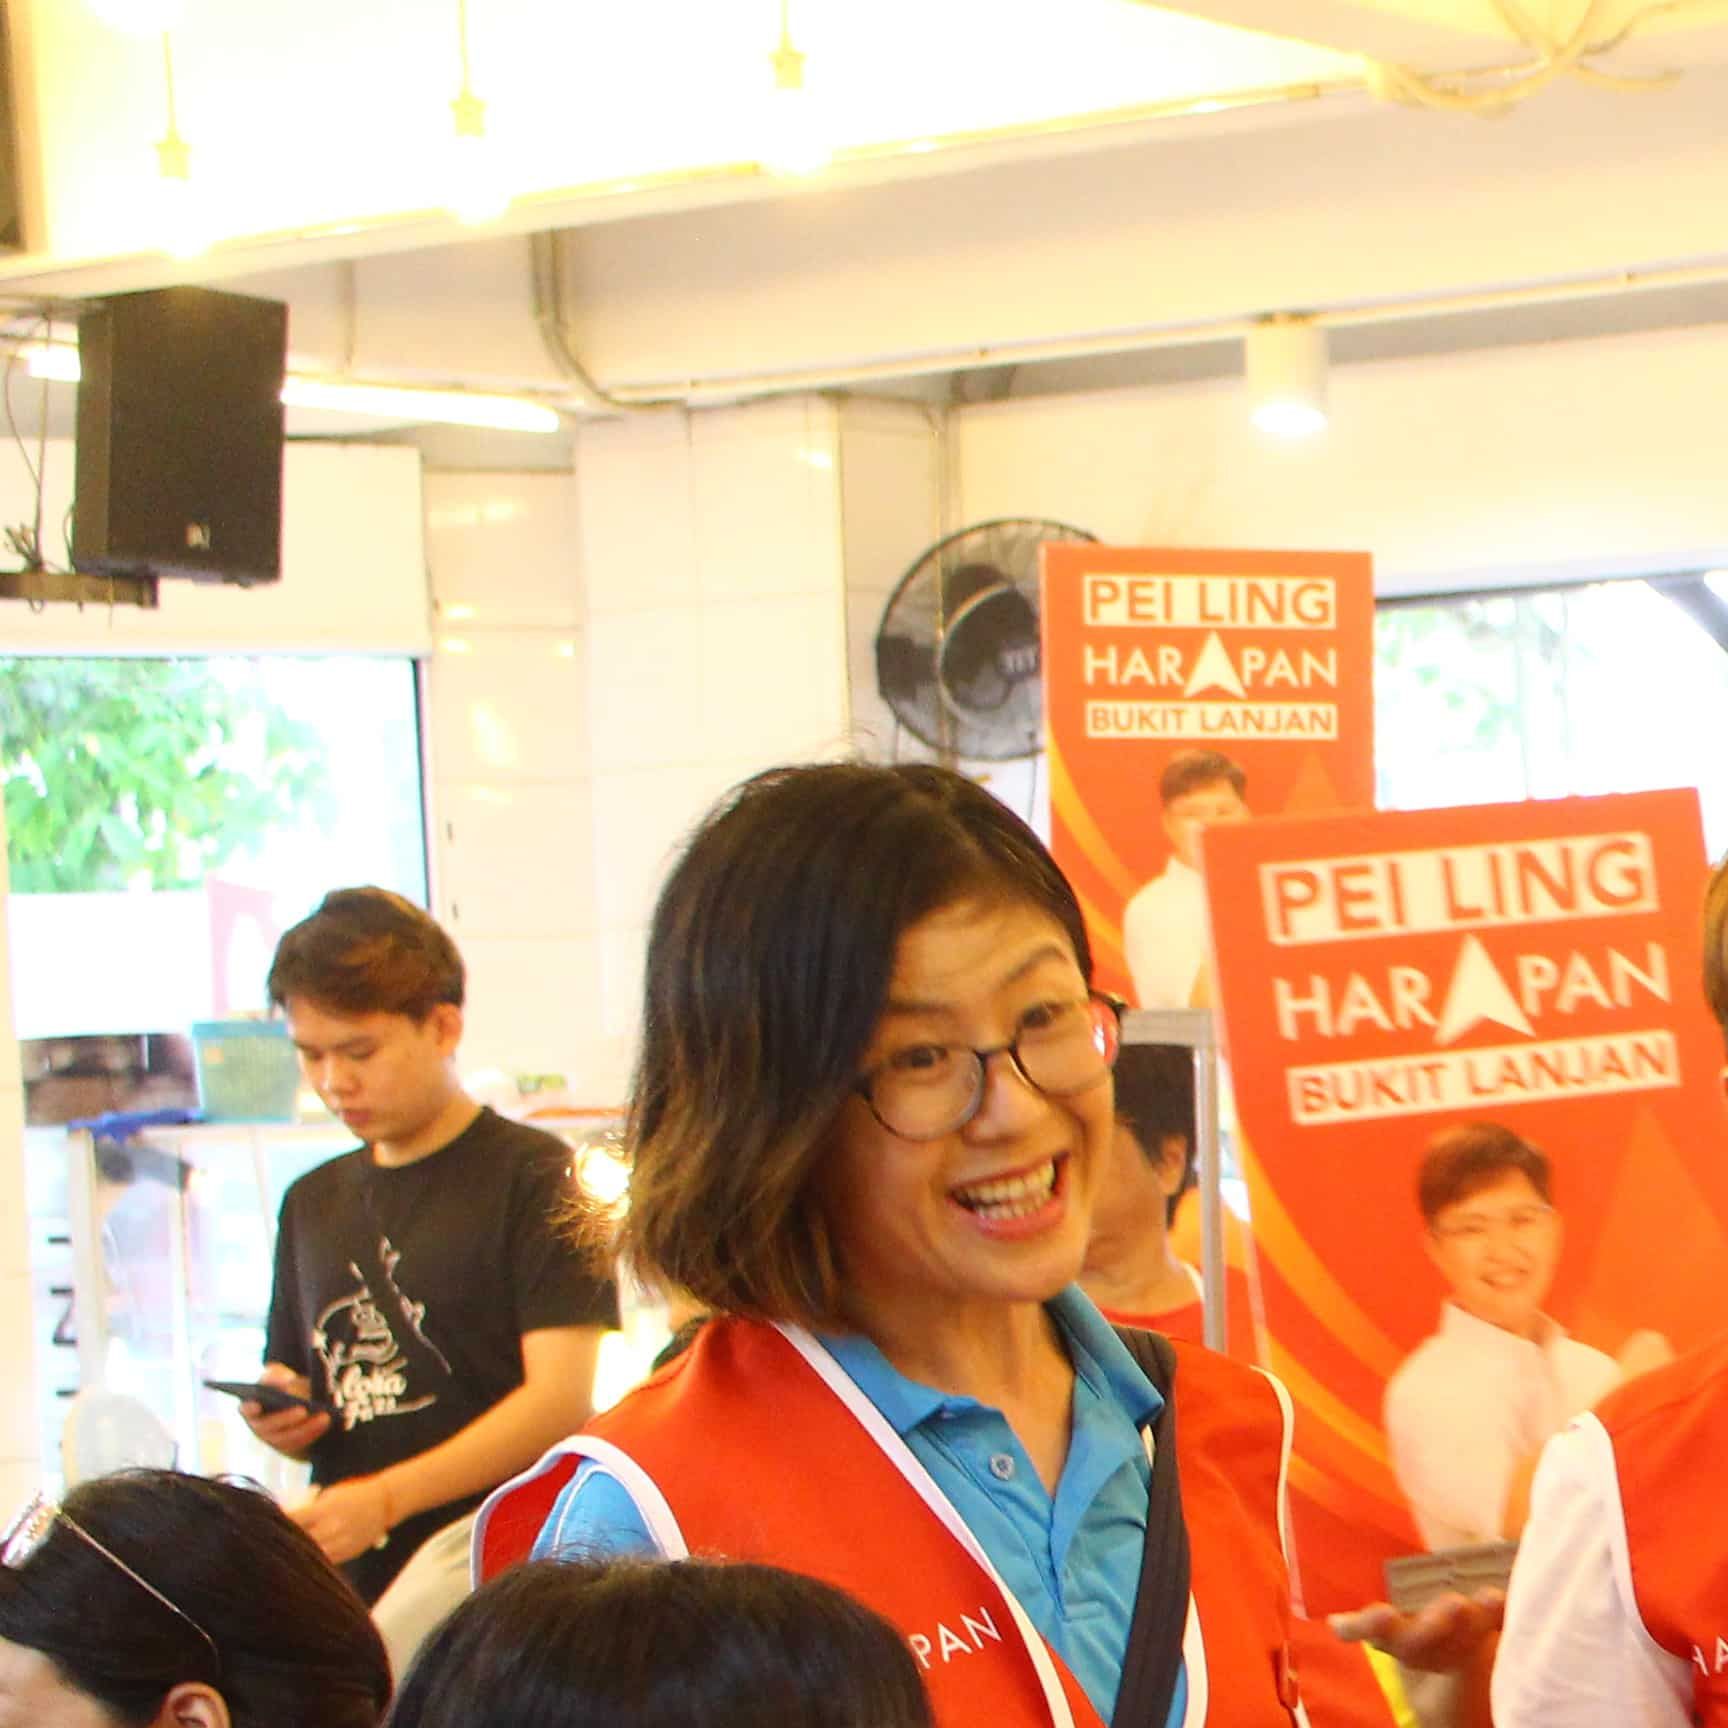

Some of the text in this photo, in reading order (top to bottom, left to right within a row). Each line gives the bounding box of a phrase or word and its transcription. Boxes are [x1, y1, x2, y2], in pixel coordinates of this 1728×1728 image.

[1090, 580, 1329, 625] PEI LING
[1084, 632, 1338, 699] HARAPAN
[1091, 706, 1332, 734] BUKIT LANJAN
[1273, 839, 1643, 937] PEI LING
[1272, 932, 1671, 1046] HARAPAN
[1300, 1040, 1668, 1115] BUKIT LANJAN
[908, 1607, 1003, 1671] PAN
